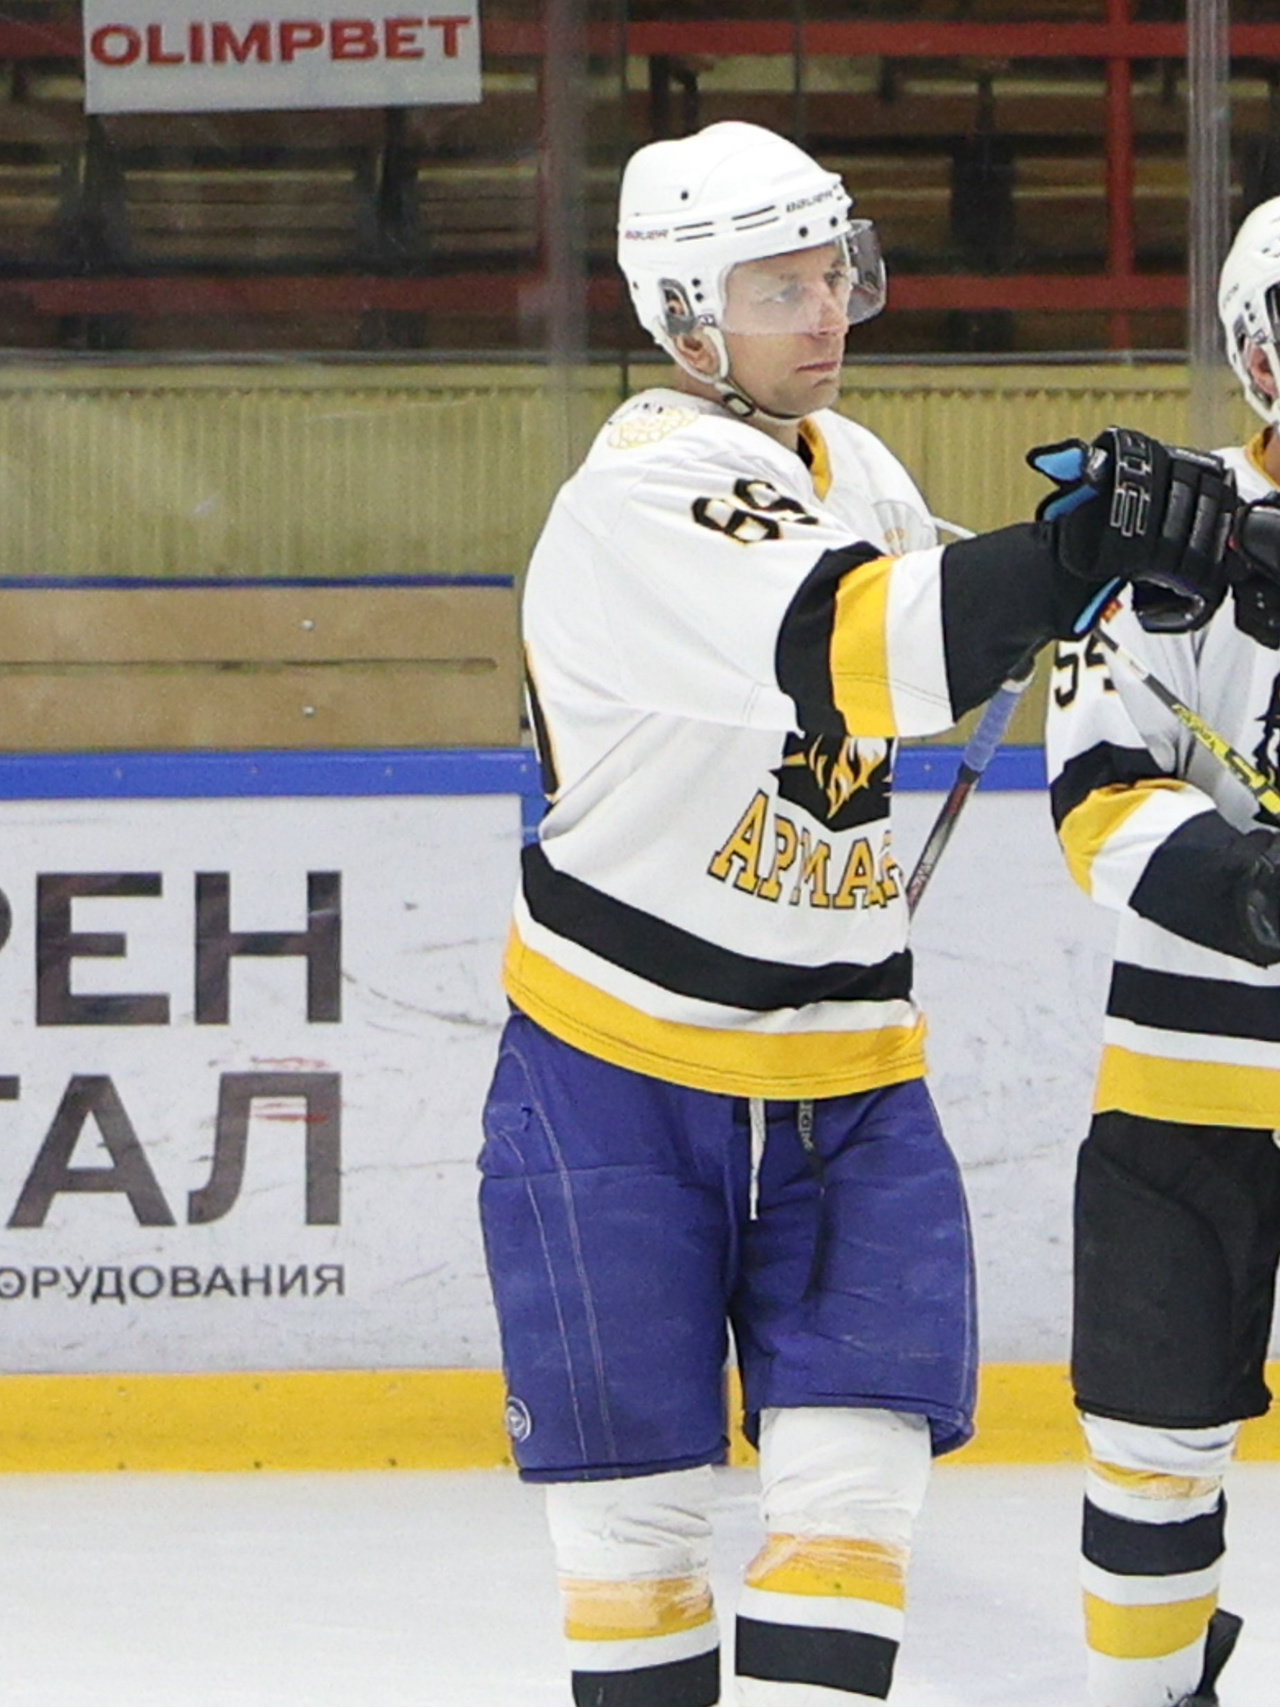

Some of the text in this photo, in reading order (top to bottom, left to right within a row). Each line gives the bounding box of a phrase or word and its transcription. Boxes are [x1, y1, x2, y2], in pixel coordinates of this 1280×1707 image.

[90, 14, 472, 67] OLIMPBET
[0, 870, 343, 1027] ЕН
[0, 1071, 343, 1229] АЛ
[0, 1263, 348, 1306] ОРУДОВАНИЯ
